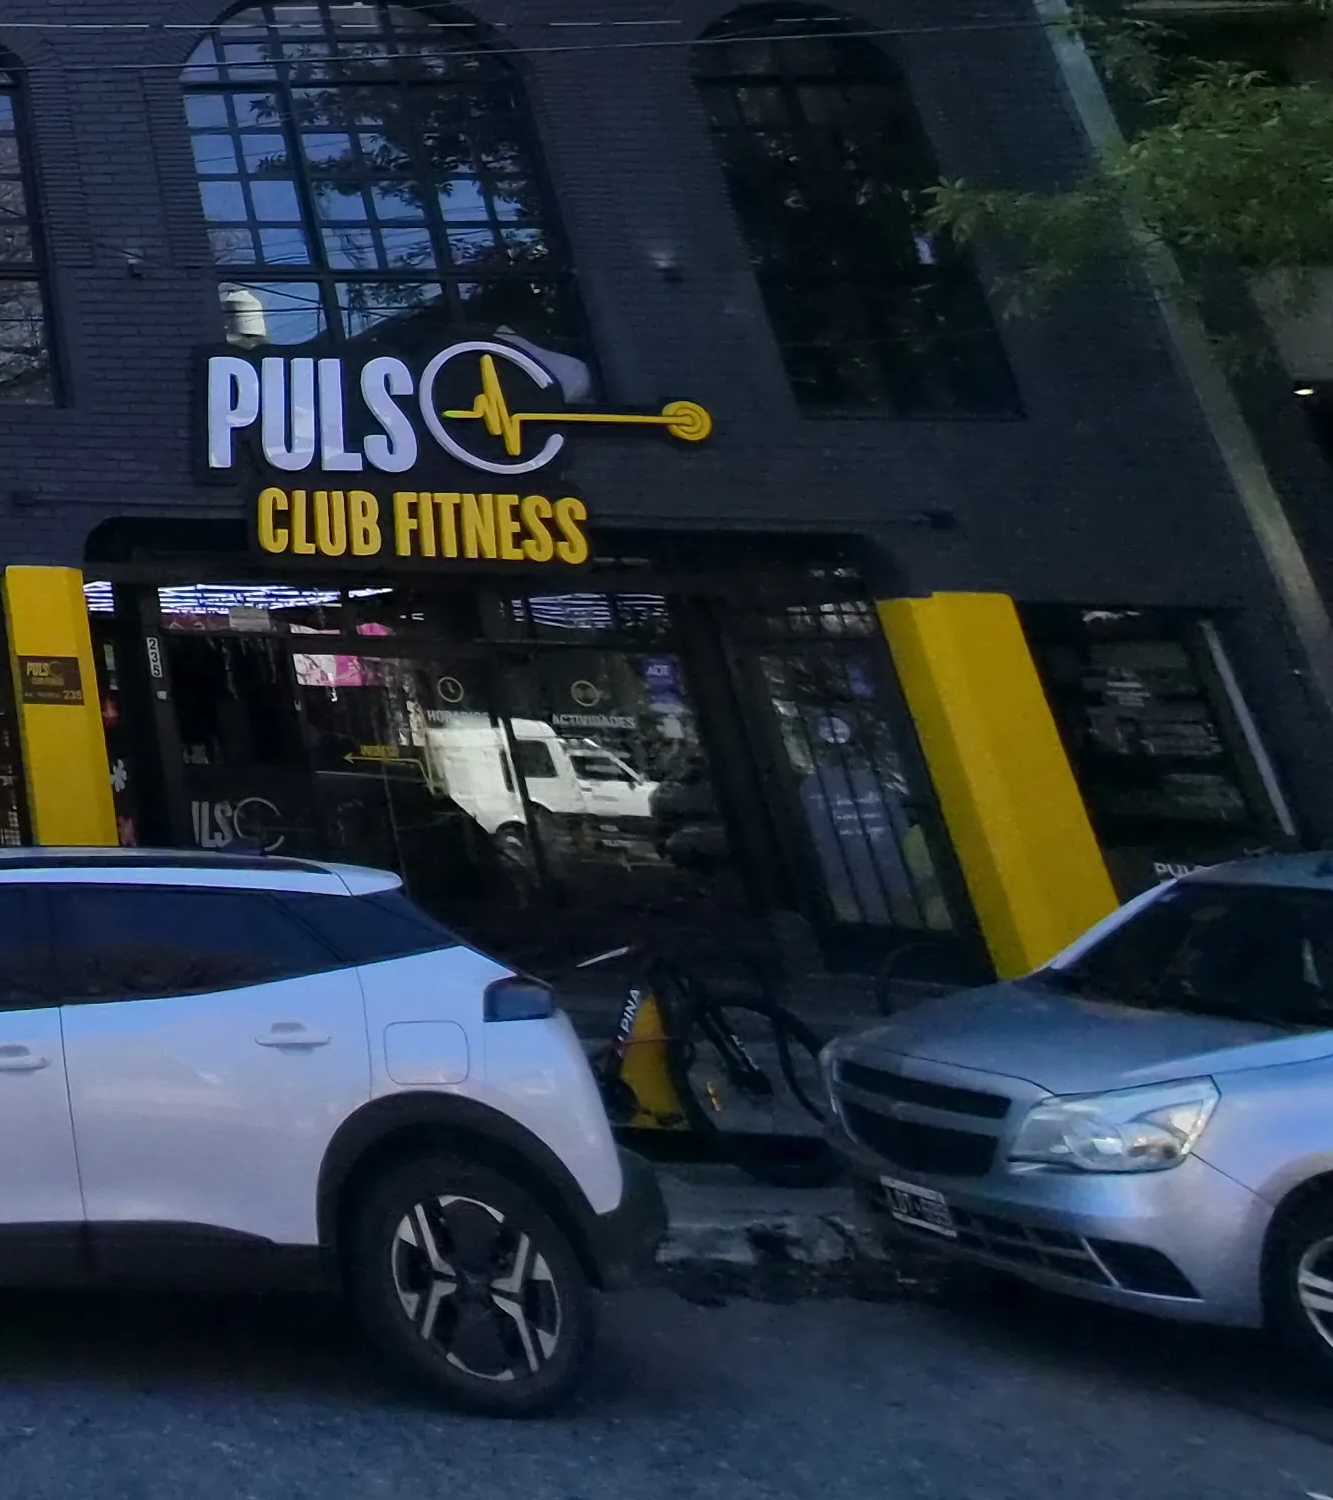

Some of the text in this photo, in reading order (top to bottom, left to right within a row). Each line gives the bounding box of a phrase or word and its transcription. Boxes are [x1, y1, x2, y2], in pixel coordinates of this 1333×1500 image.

[257, 487, 589, 565] CLUB FITNESS
[148, 638, 161, 677] 235
[552, 712, 636, 730] ACTIVIDADES
